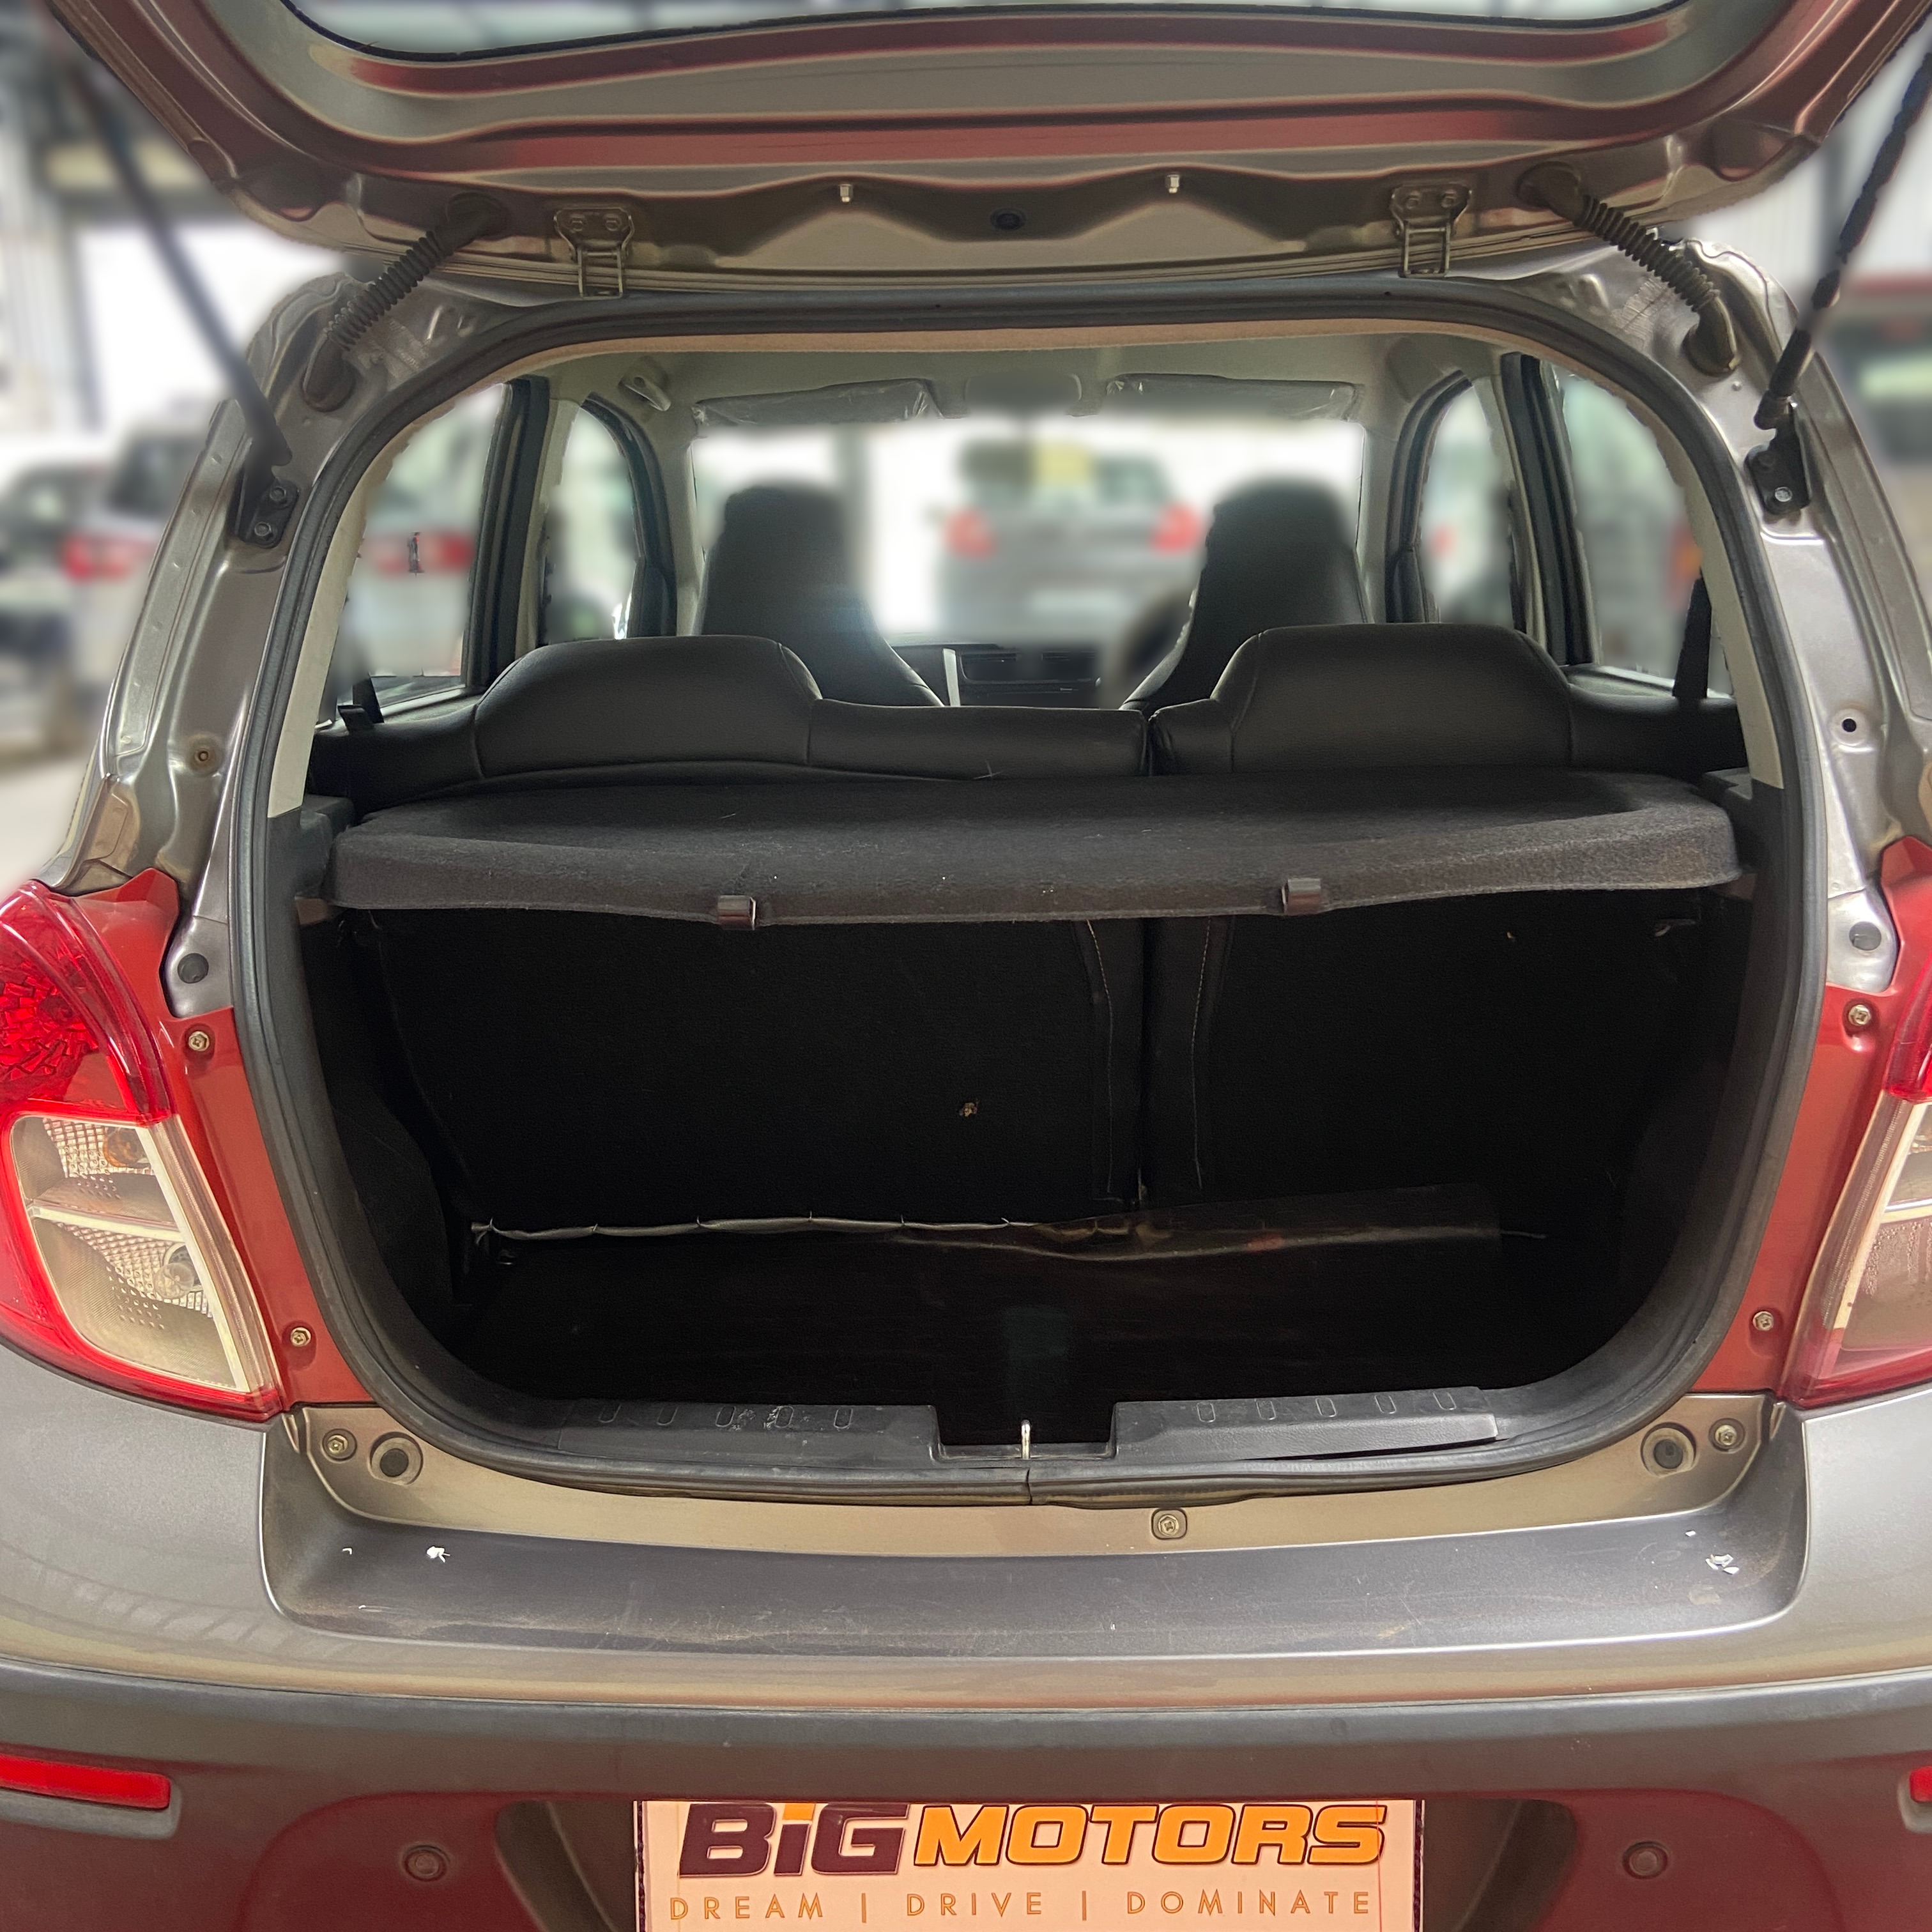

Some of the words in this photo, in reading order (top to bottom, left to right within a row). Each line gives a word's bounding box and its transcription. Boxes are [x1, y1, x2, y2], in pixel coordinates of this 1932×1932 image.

[914, 1803, 1387, 1866] MOTORS
[670, 1893, 823, 1920] DREAM
[906, 1892, 1042, 1917] DRIVE
[1127, 1889, 1369, 1917] DOMINATE
